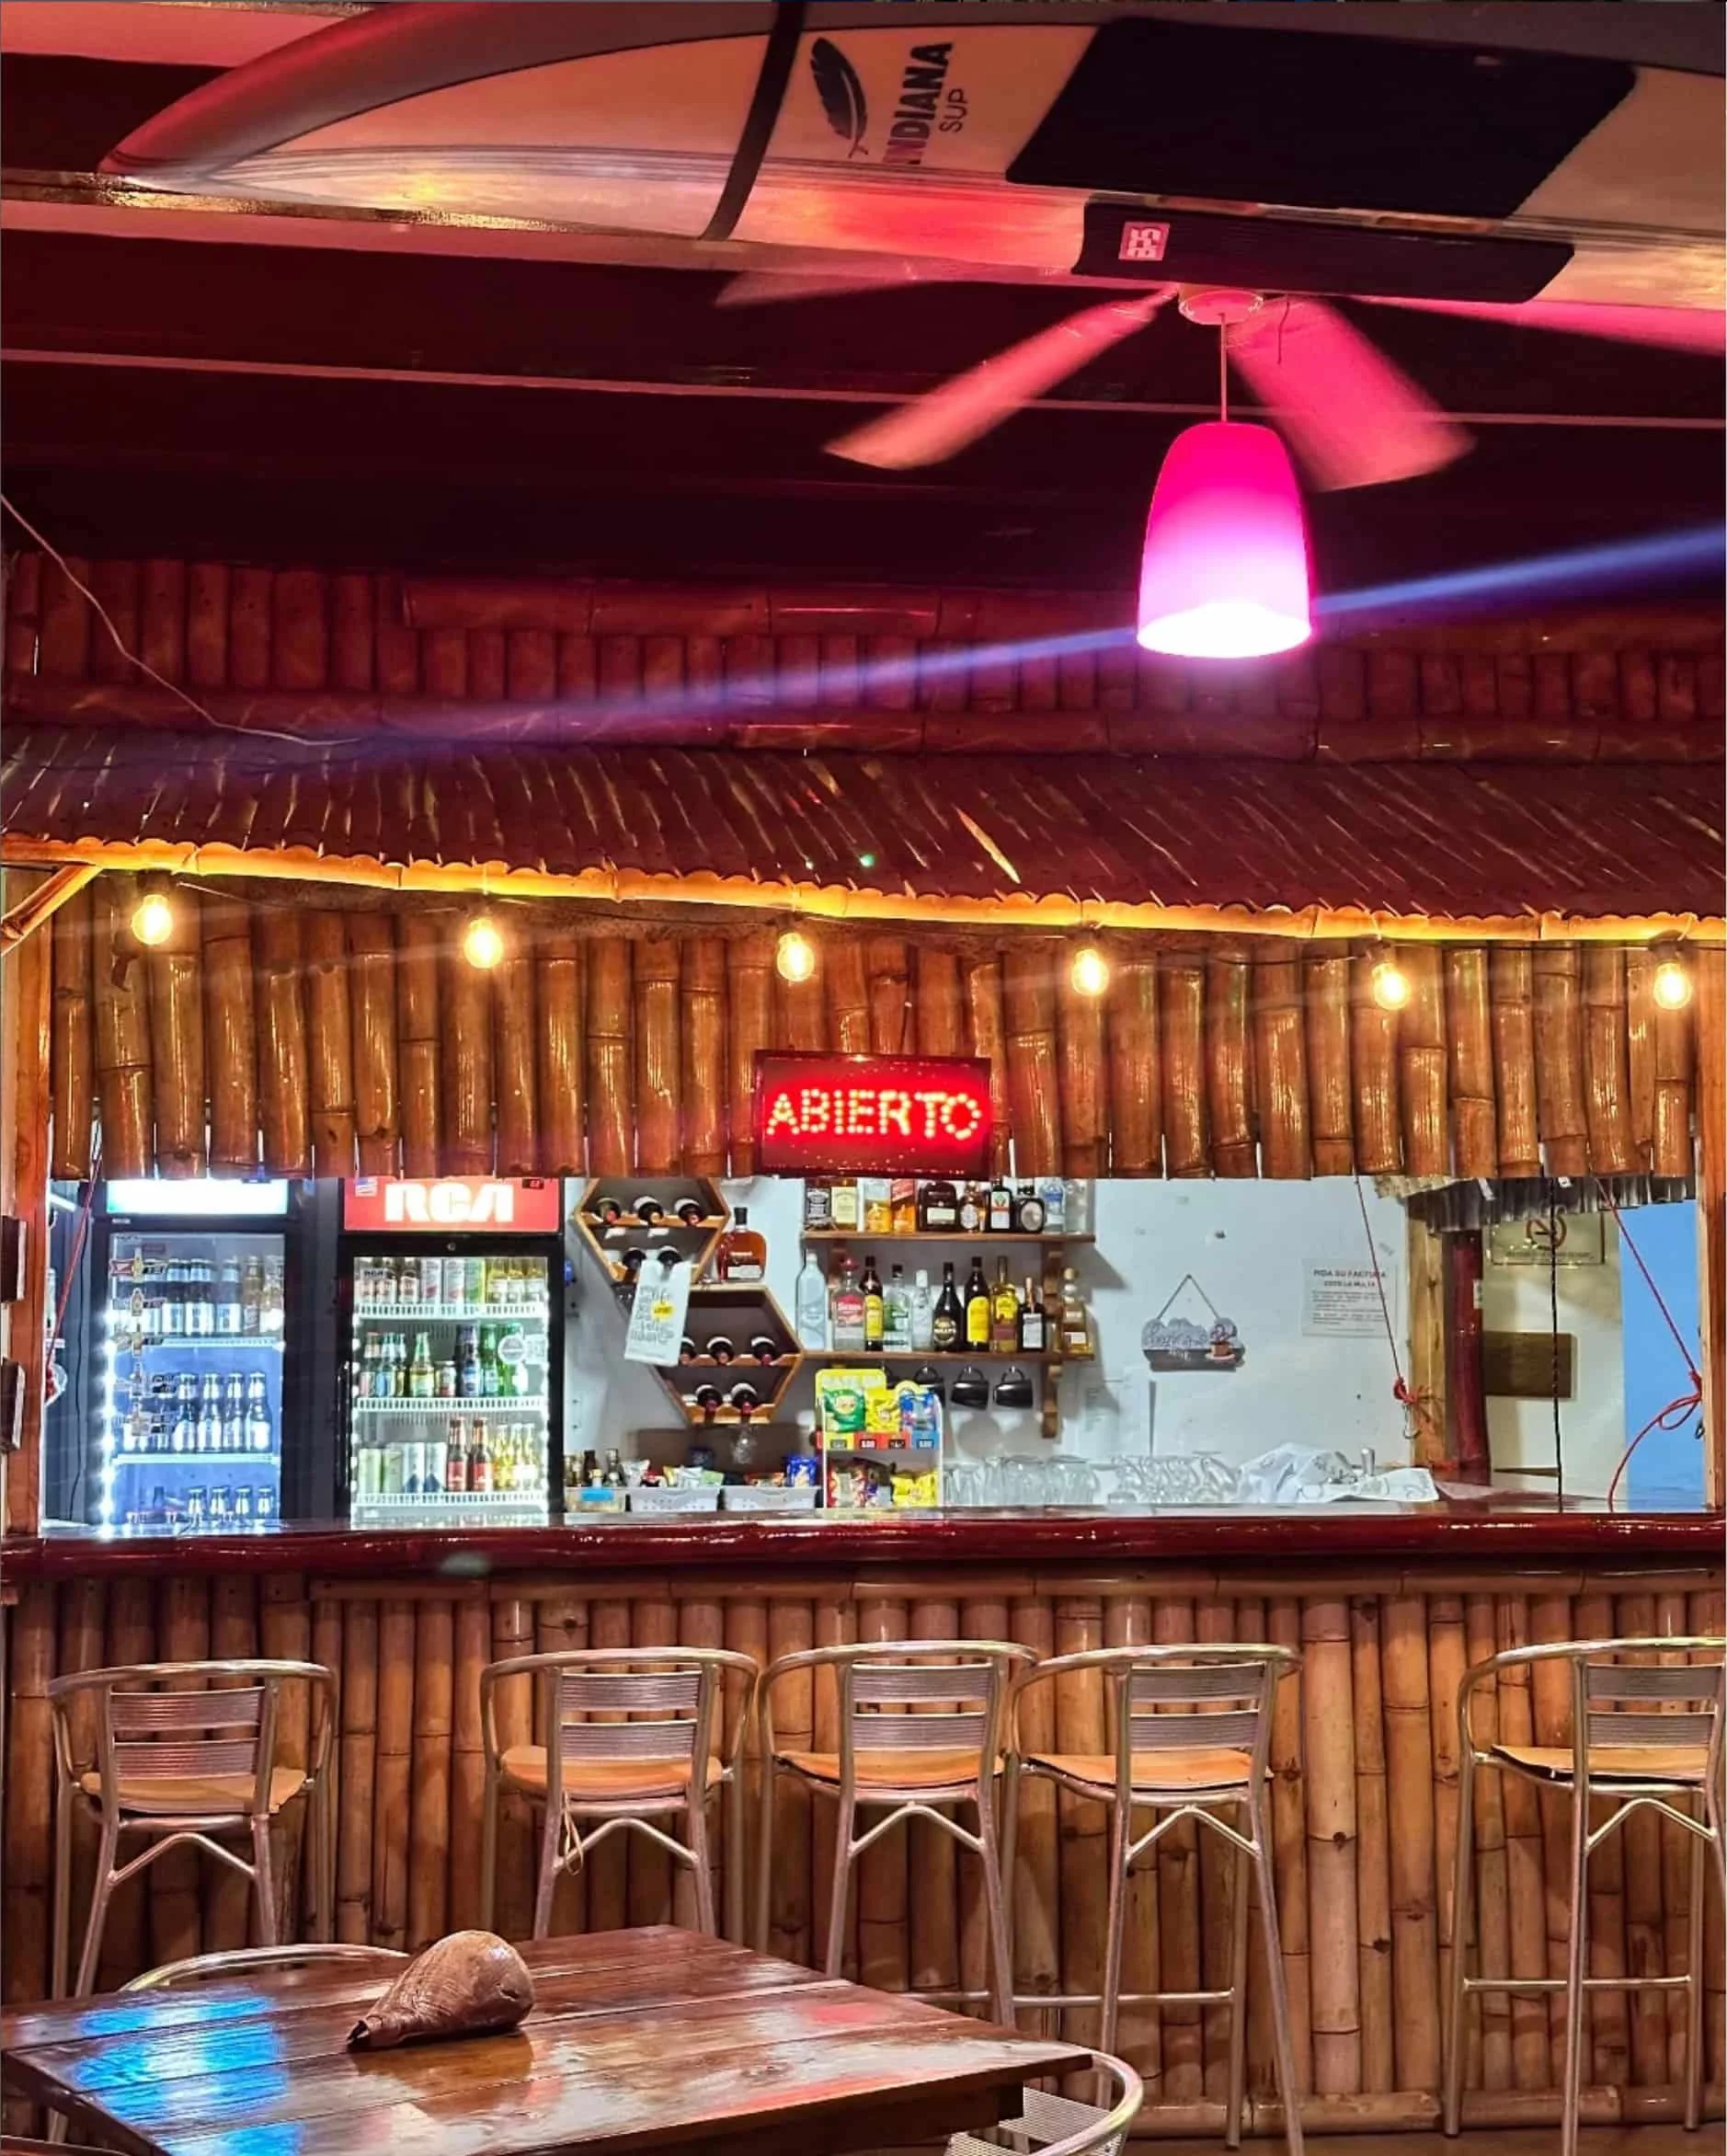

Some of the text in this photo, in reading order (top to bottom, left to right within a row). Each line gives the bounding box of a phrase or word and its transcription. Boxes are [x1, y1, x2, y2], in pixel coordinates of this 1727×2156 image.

[882, 41, 953, 165] INDIANA
[939, 88, 968, 132] SUP
[766, 1088, 981, 1141] ABIERTO
[384, 1183, 514, 1221] RCA
